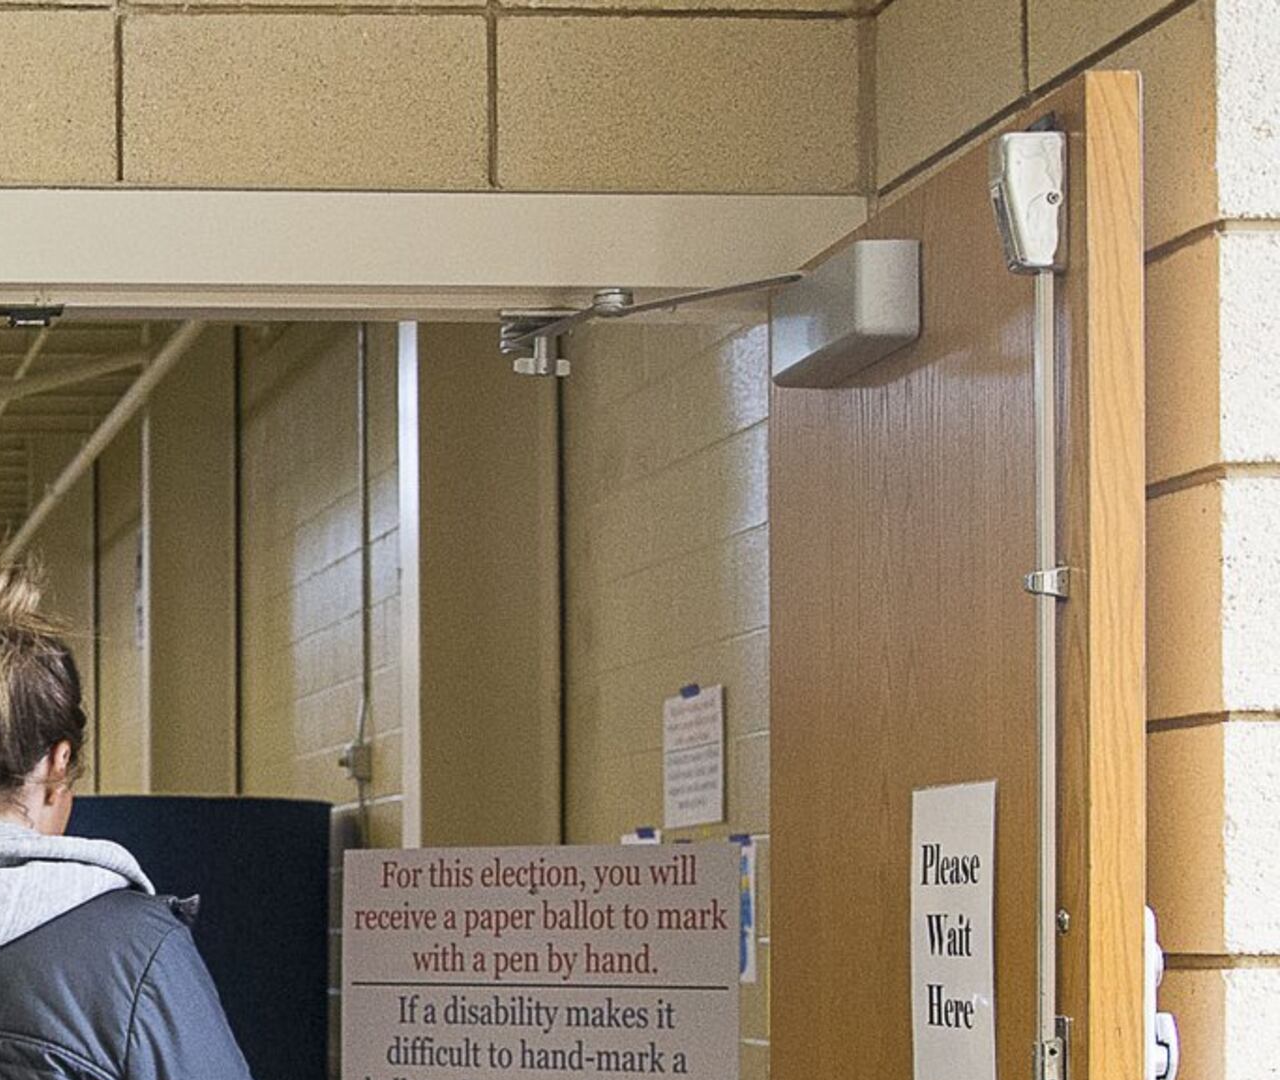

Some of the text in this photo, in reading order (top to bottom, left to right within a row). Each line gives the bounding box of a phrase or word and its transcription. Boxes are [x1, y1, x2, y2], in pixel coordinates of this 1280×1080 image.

[381, 855, 696, 894] For this election, you will
[921, 844, 980, 885] Please
[355, 899, 728, 938] receive a paper ballot to mark
[926, 914, 972, 956] Wait
[412, 943, 658, 980] with a pen by hand.
[399, 995, 675, 1033] If a disability makes it
[927, 984, 974, 1028] Here
[386, 1036, 688, 1074] difficult to hand-mark a
